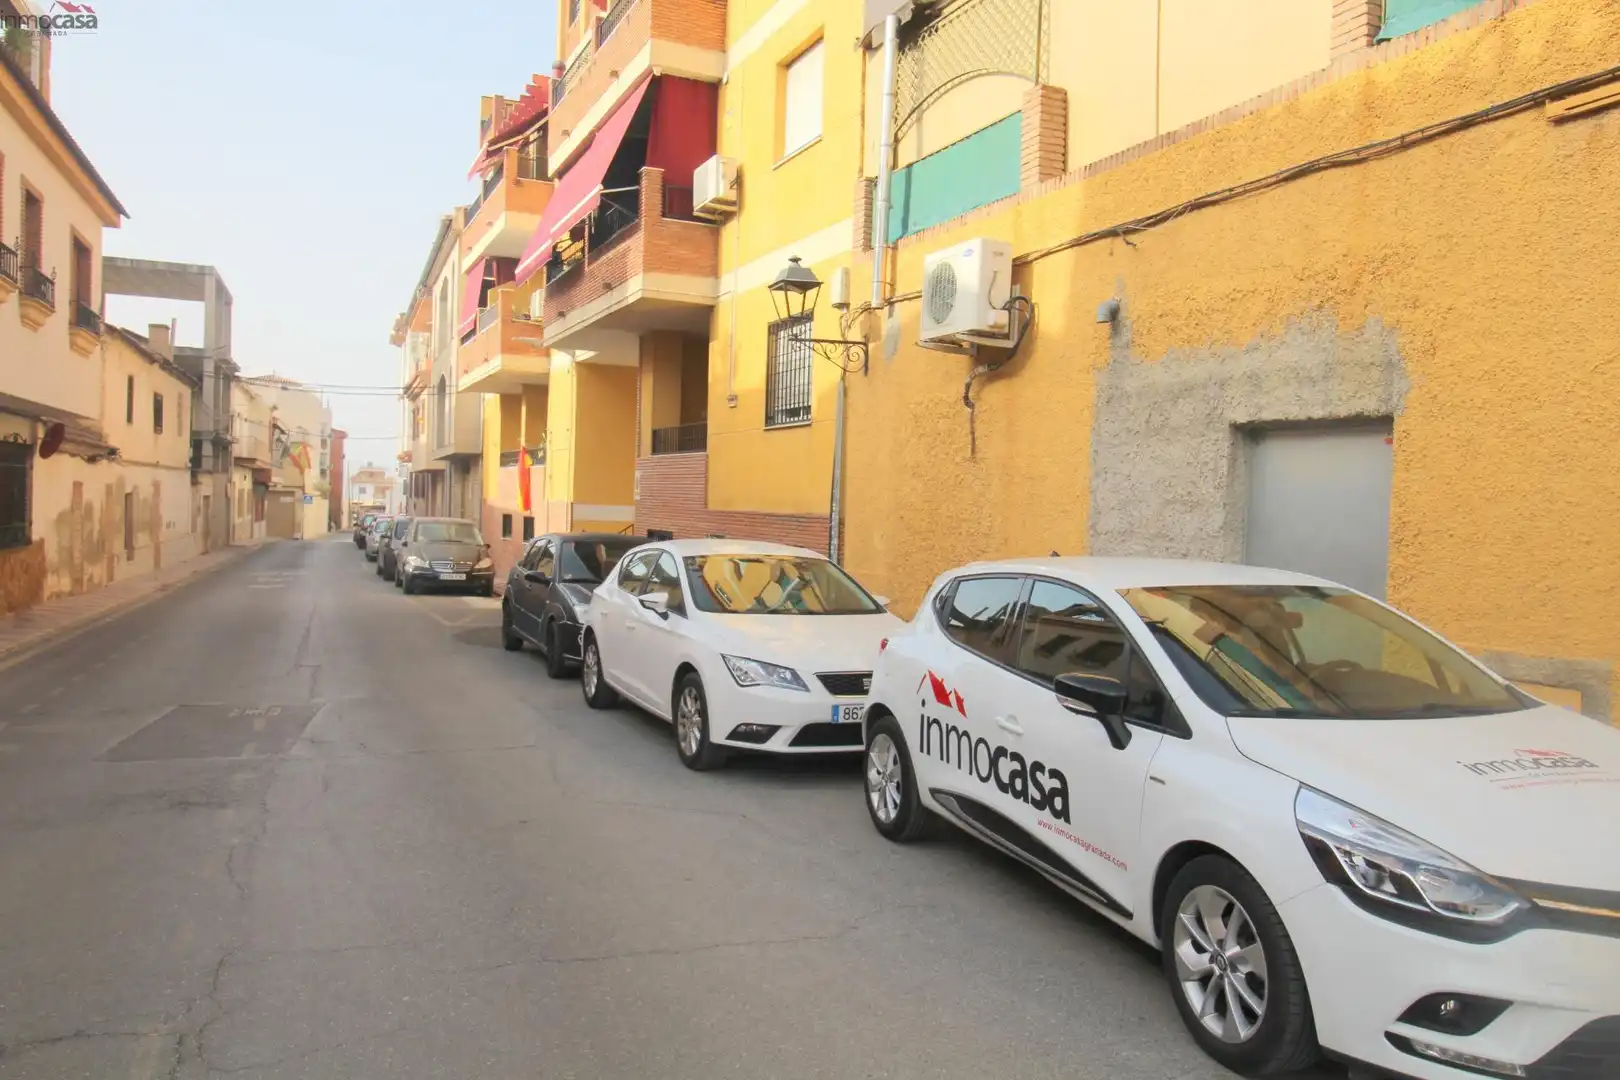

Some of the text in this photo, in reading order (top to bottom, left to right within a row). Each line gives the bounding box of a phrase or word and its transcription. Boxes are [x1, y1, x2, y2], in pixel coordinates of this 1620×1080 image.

[920, 698, 1072, 825] inmocasa
[1456, 757, 1599, 776] inmocasa
[1037, 818, 1128, 872] www.inmocasagranada.com
